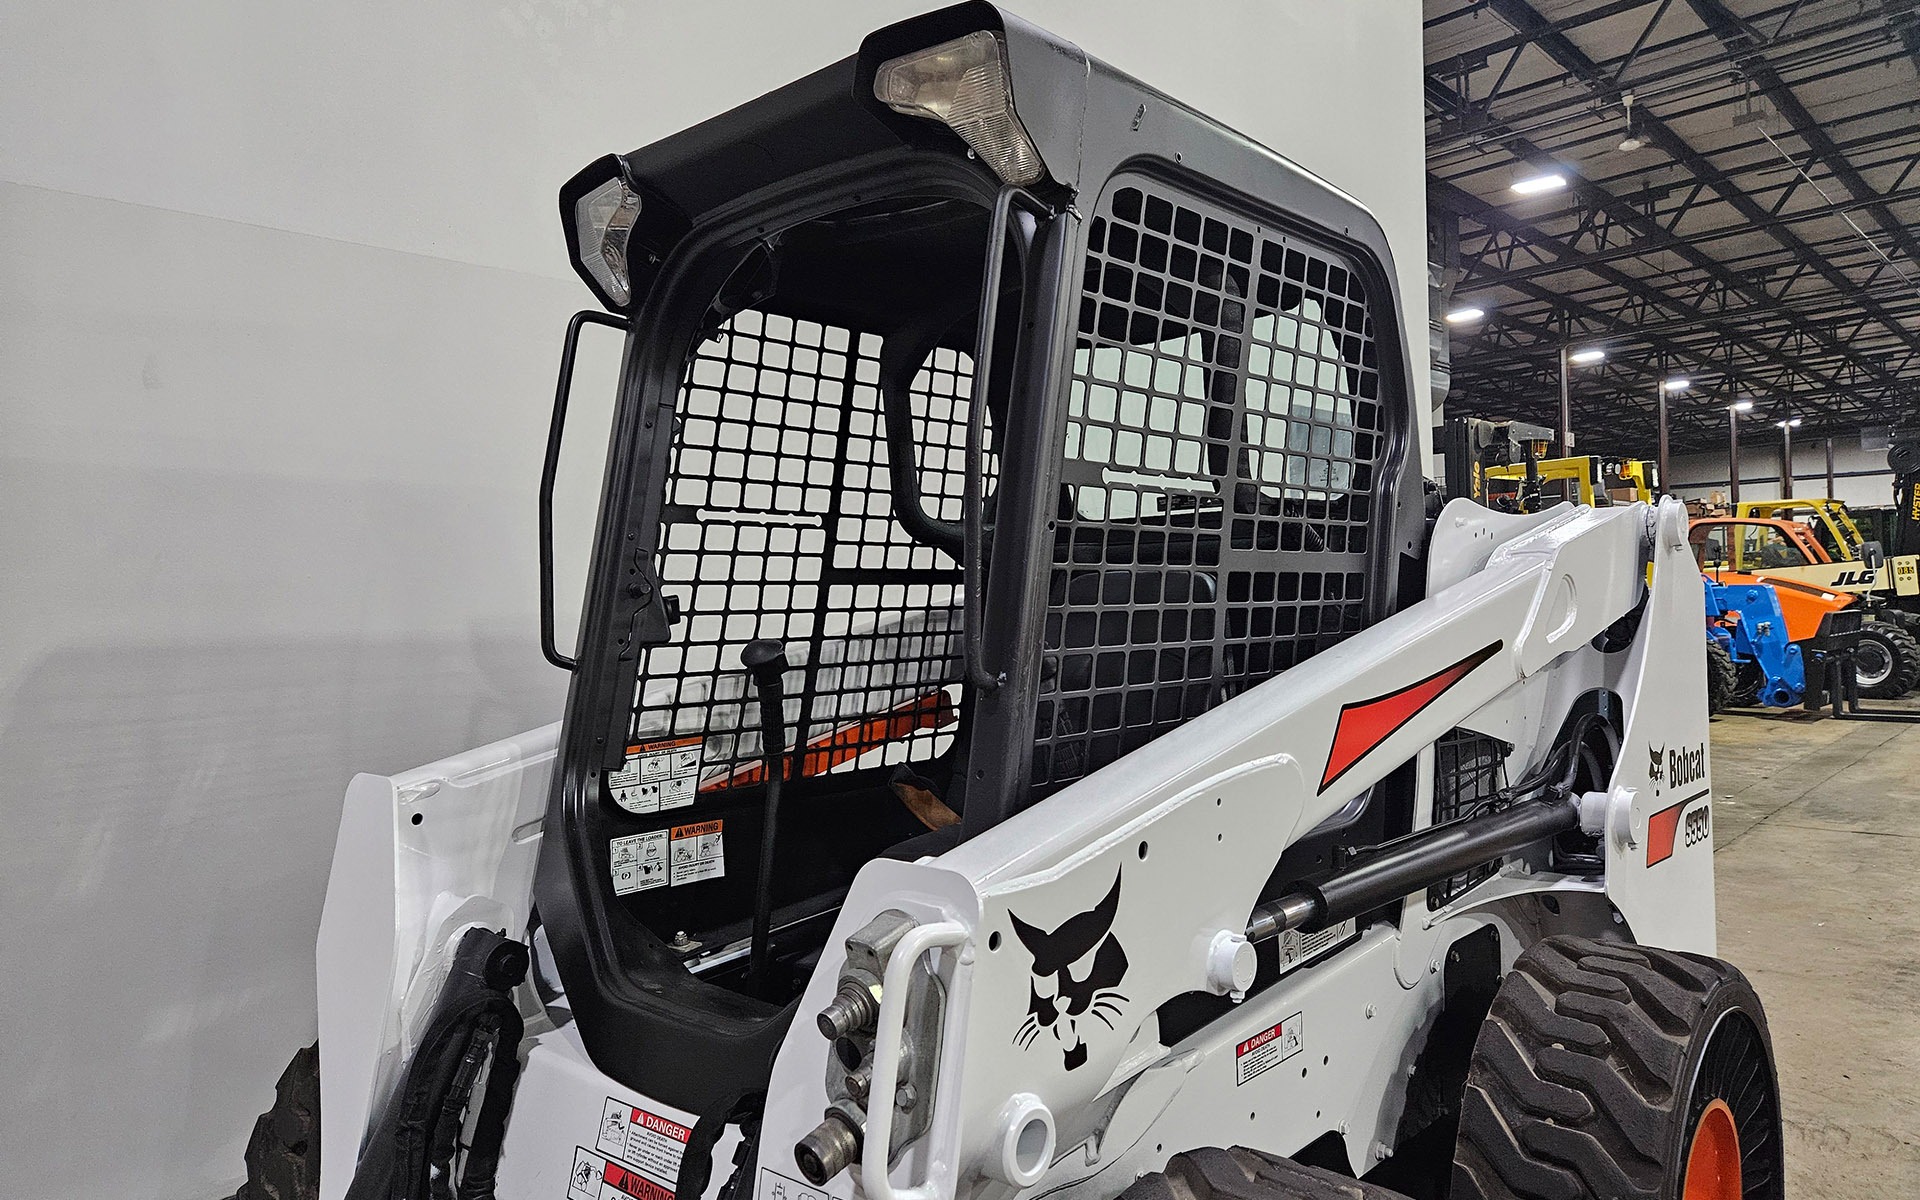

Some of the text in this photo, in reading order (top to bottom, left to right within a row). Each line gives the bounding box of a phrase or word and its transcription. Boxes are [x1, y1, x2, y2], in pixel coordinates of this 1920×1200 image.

[1911, 482, 1920, 520] HYSTER
[1830, 569, 1877, 587] JLG
[648, 741, 676, 750] WARNING
[1669, 742, 1705, 789] Bobcat
[684, 822, 719, 836] WARNING
[1251, 1029, 1275, 1049] DANGER
[646, 1116, 686, 1141] DANGER
